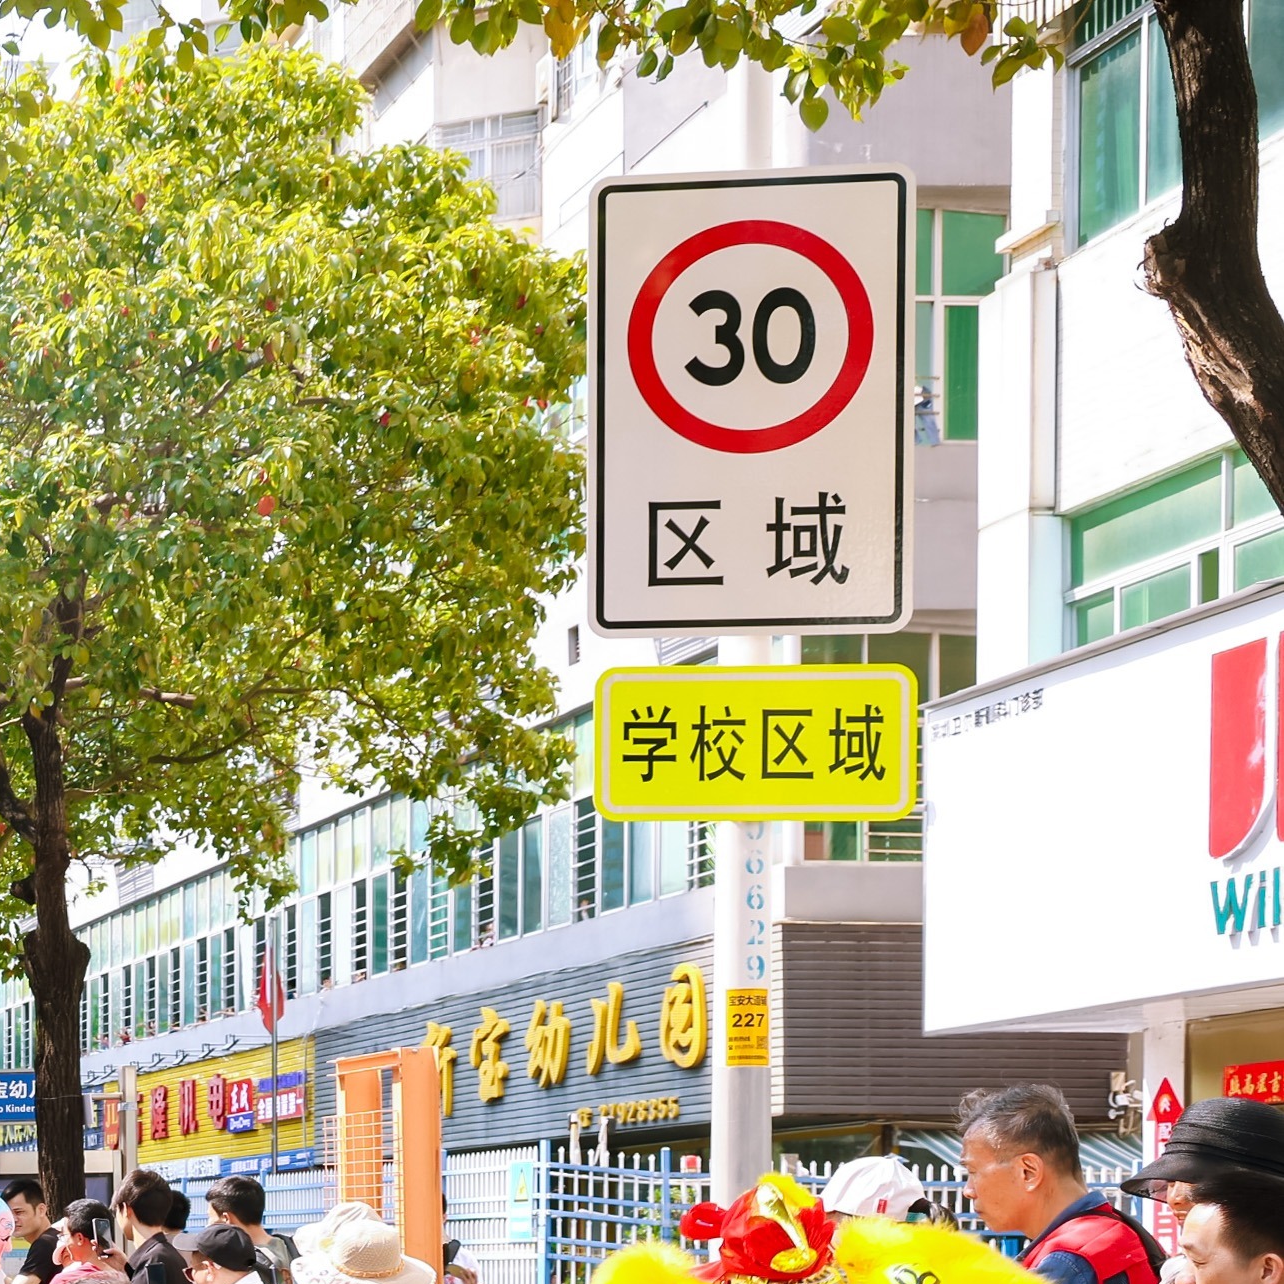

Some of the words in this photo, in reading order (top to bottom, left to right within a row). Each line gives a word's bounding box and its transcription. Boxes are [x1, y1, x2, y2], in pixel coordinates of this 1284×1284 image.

[684, 287, 817, 387] 30
[647, 491, 851, 588] 区域
[622, 703, 888, 783] 学校区域
[732, 1013, 765, 1028] 227
